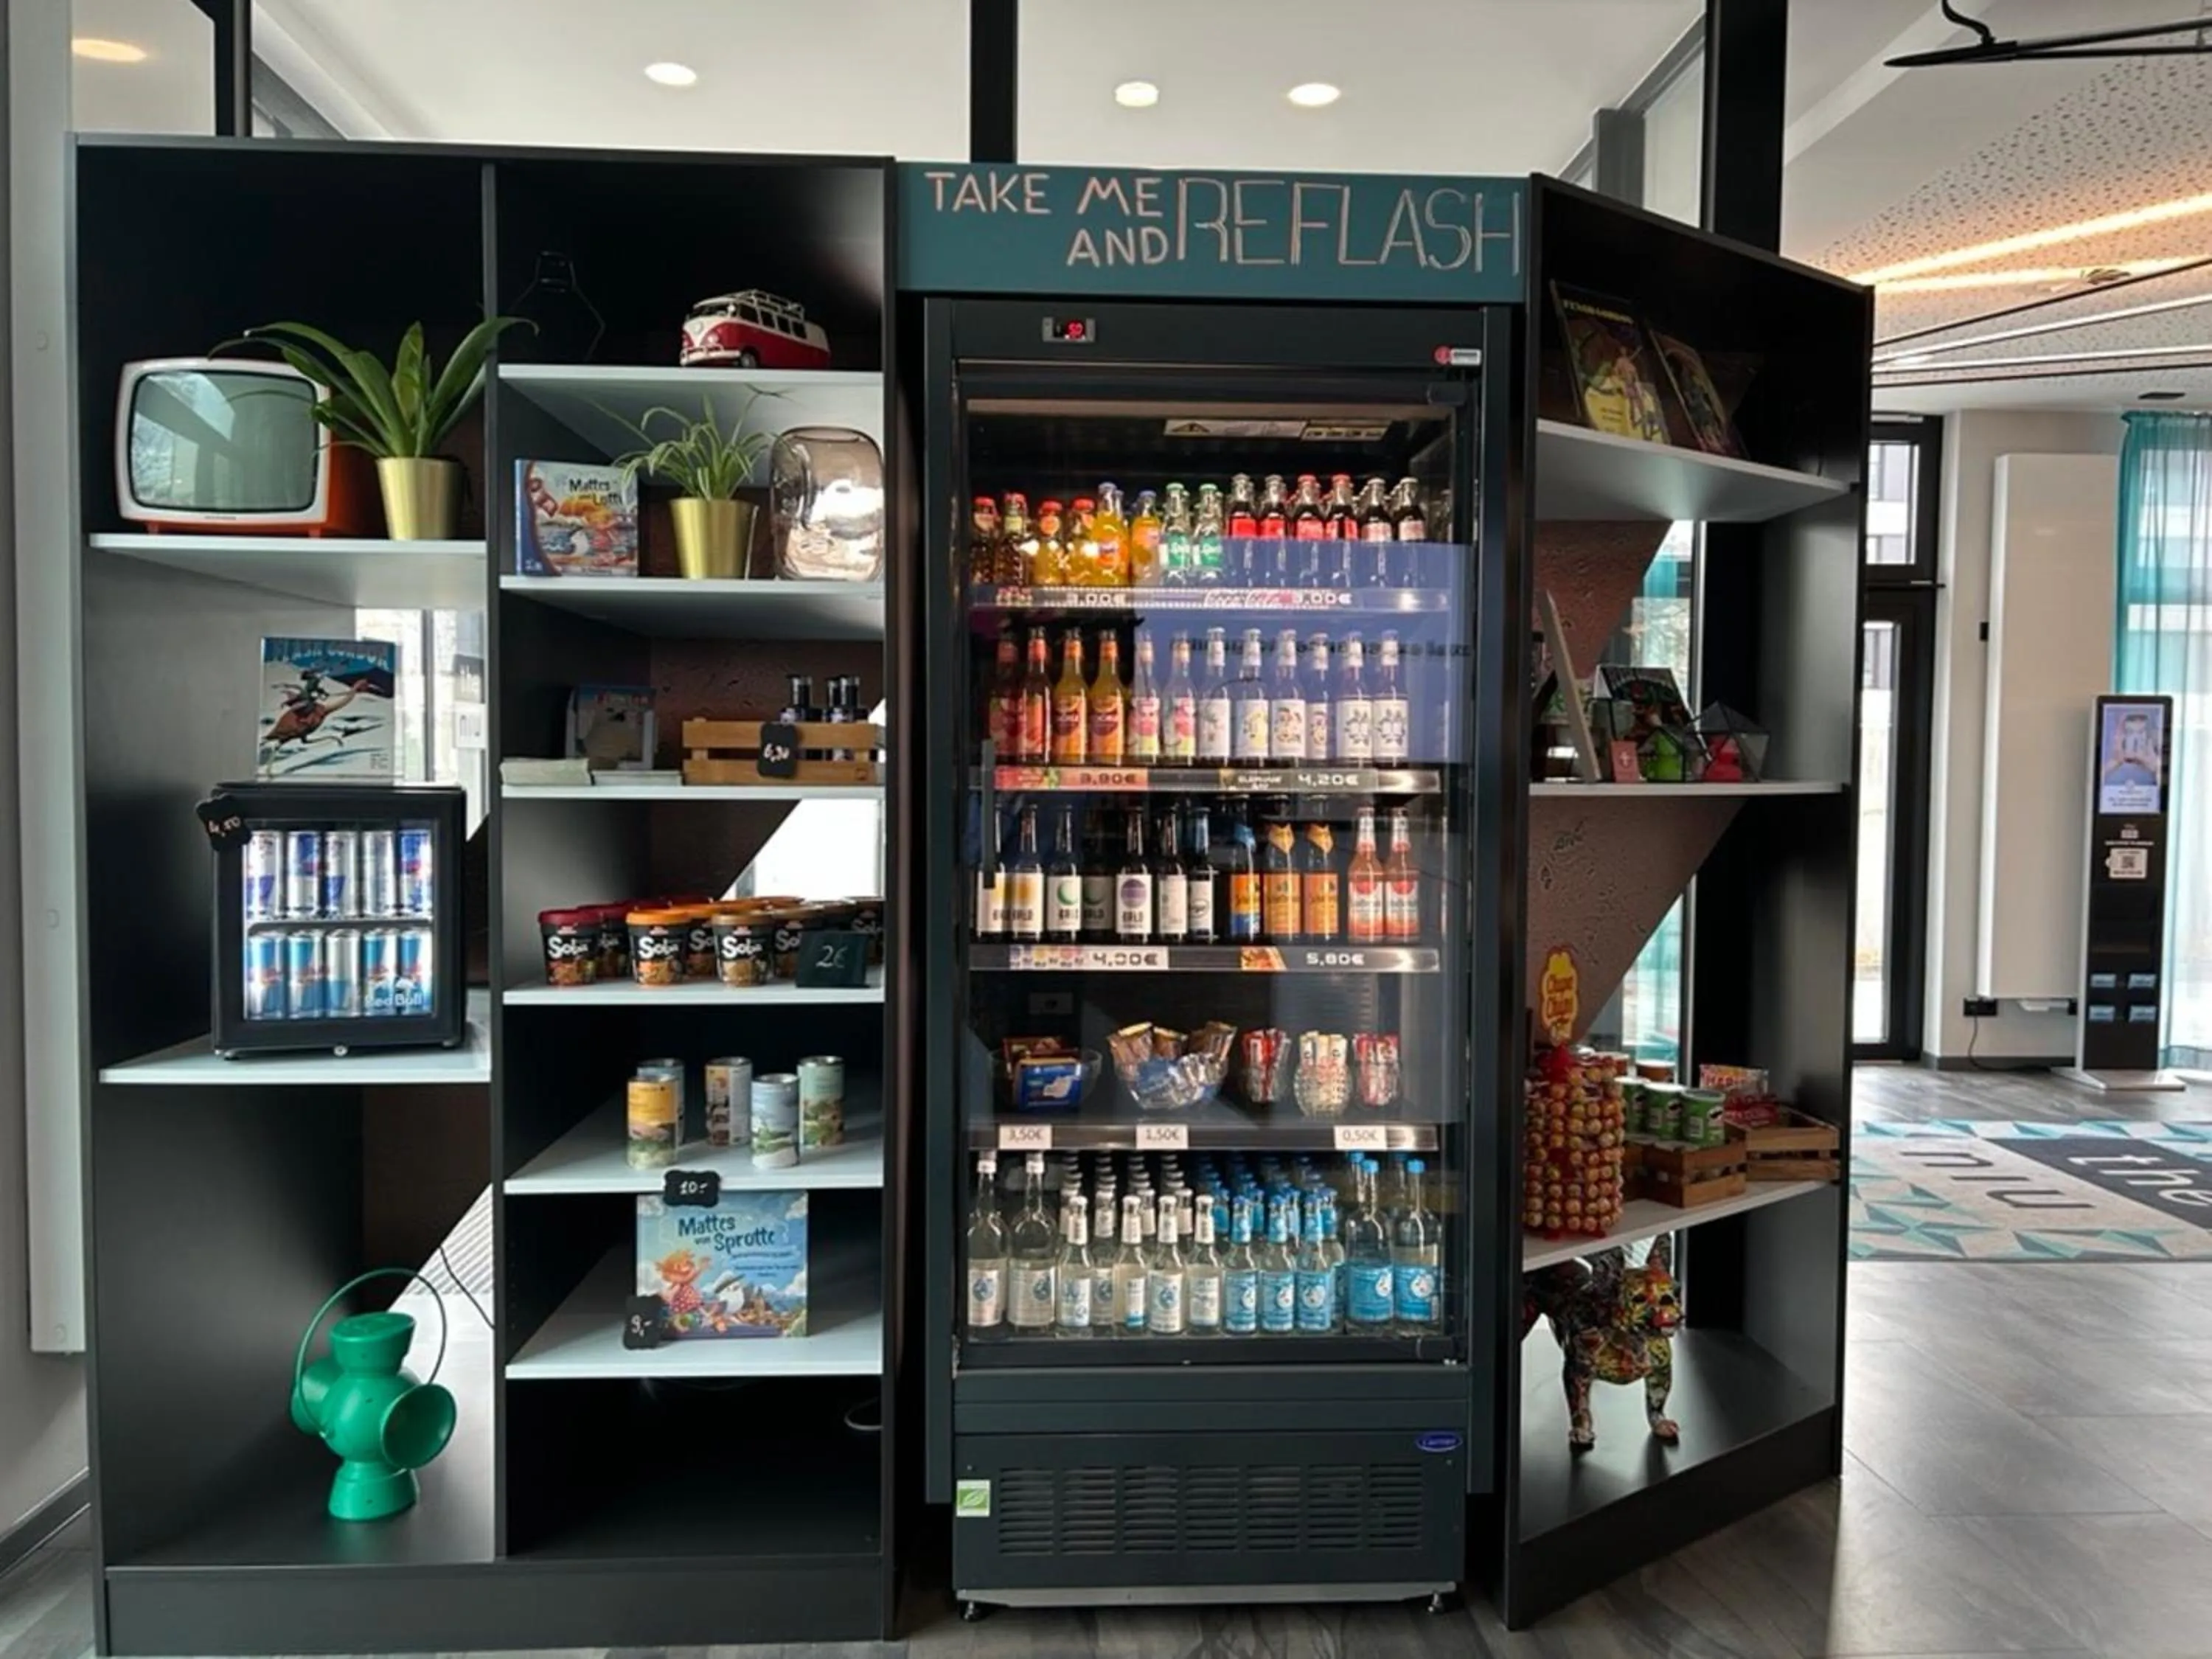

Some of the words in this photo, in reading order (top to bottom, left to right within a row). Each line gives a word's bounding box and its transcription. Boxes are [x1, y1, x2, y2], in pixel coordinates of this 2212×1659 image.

[925, 171, 1051, 214] TAKE
[1077, 177, 1164, 218] ME
[1067, 226, 1169, 268] AND
[1177, 177, 1520, 276] REFLASH
[549, 936, 588, 959] Soba
[638, 935, 678, 959] Soba
[689, 929, 714, 951] So
[722, 935, 762, 959] Soba
[815, 945, 848, 968] 2€
[678, 1215, 736, 1237] Mattes
[714, 1226, 775, 1255] Sprotte
